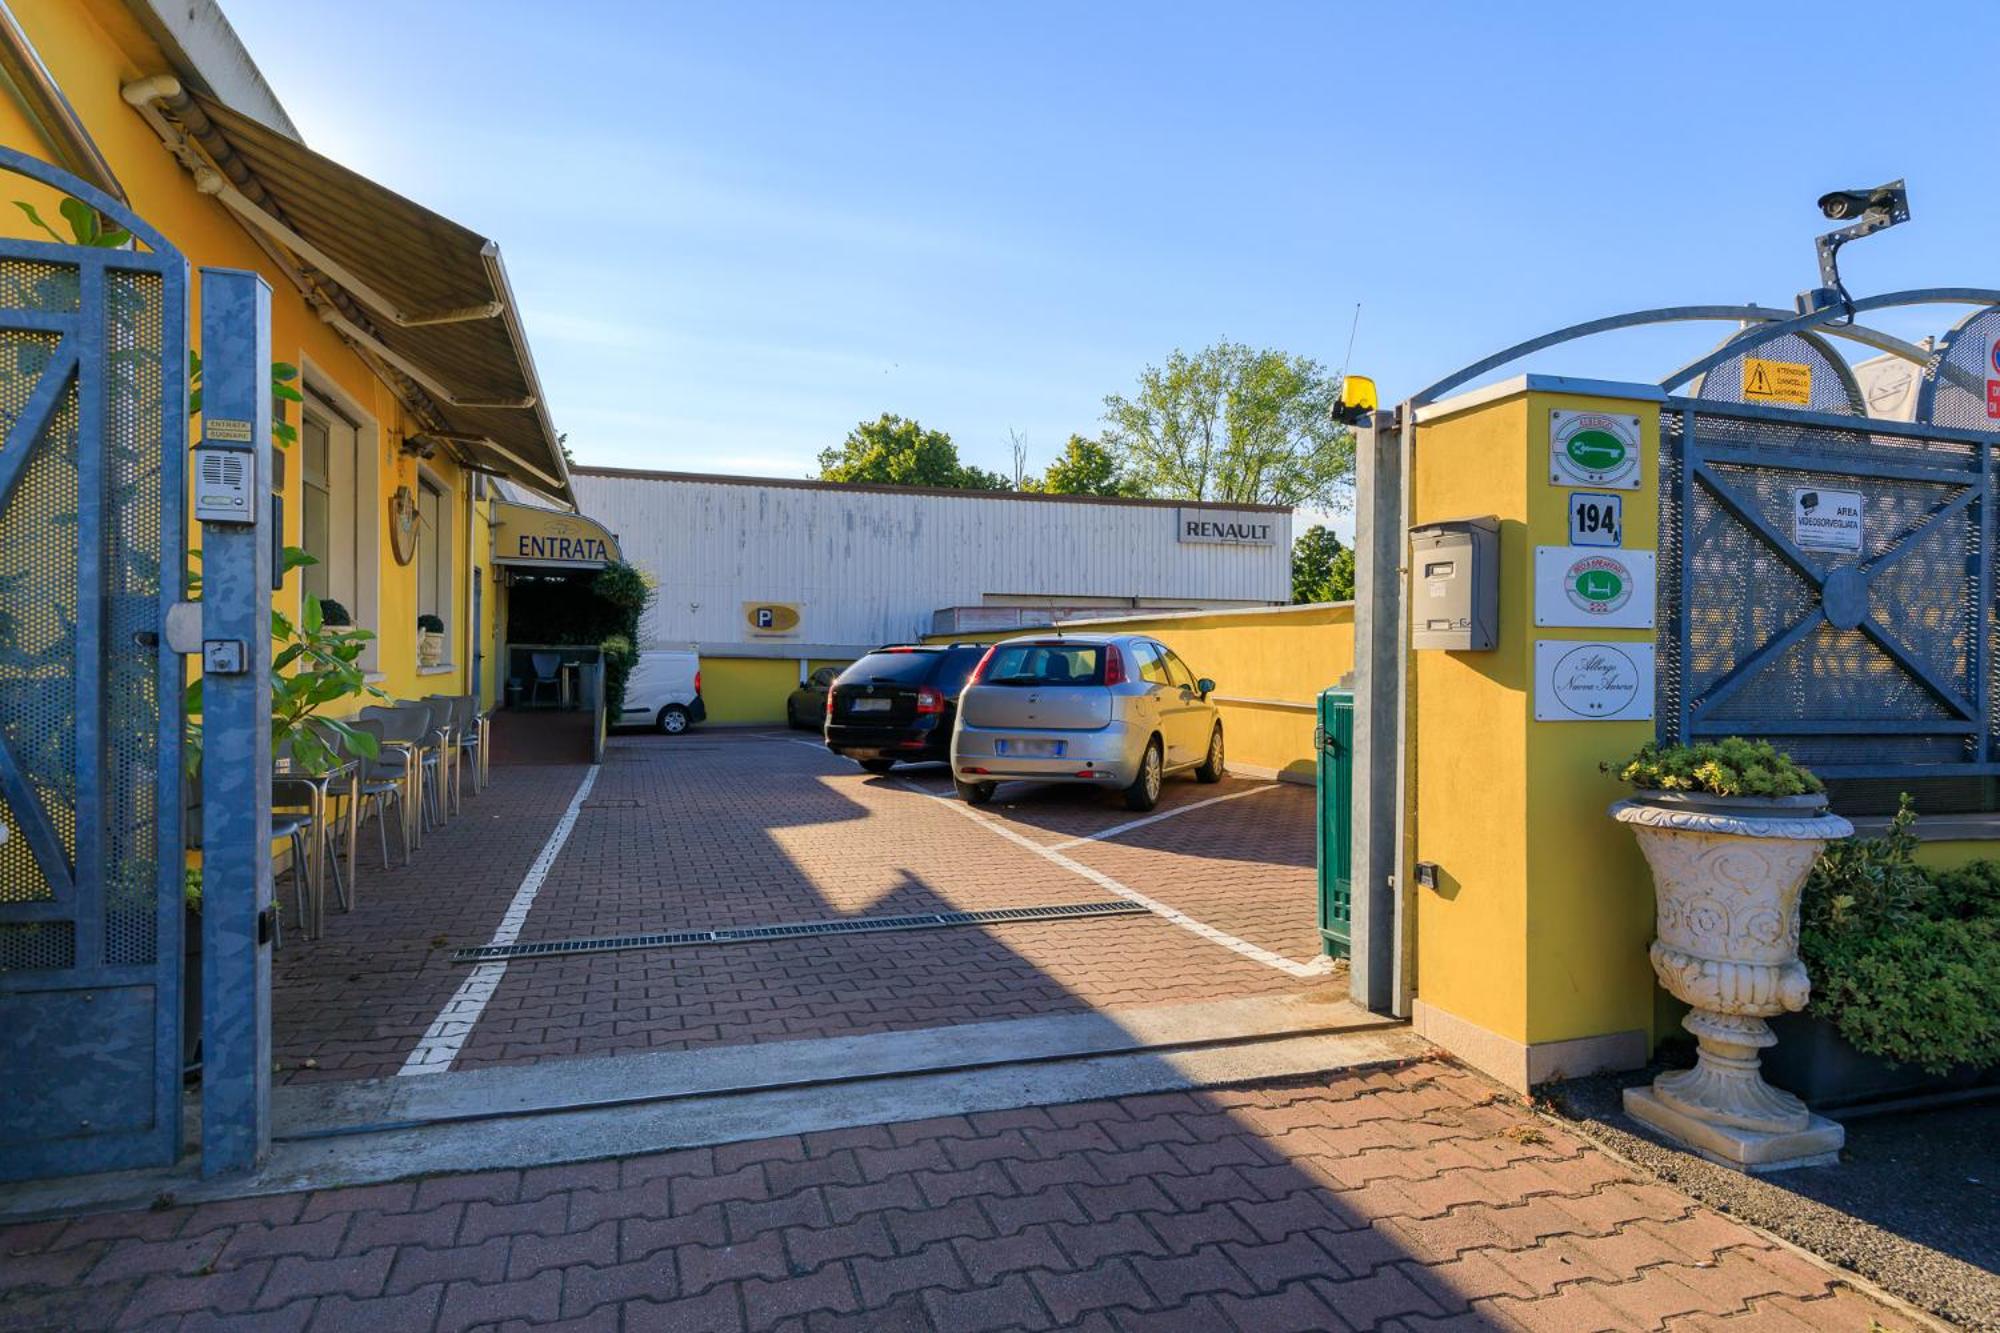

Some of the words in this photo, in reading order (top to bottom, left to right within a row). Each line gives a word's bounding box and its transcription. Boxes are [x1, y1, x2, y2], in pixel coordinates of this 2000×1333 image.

[1576, 503, 1615, 534] 194
[1836, 507, 1859, 517] AREA
[1187, 522, 1270, 539] RENAULT
[1798, 516, 1859, 529] VIDEOSORVEGLIATA
[518, 535, 609, 560] ENTRATA
[759, 610, 771, 627] P
[1575, 654, 1617, 676] Albergo
